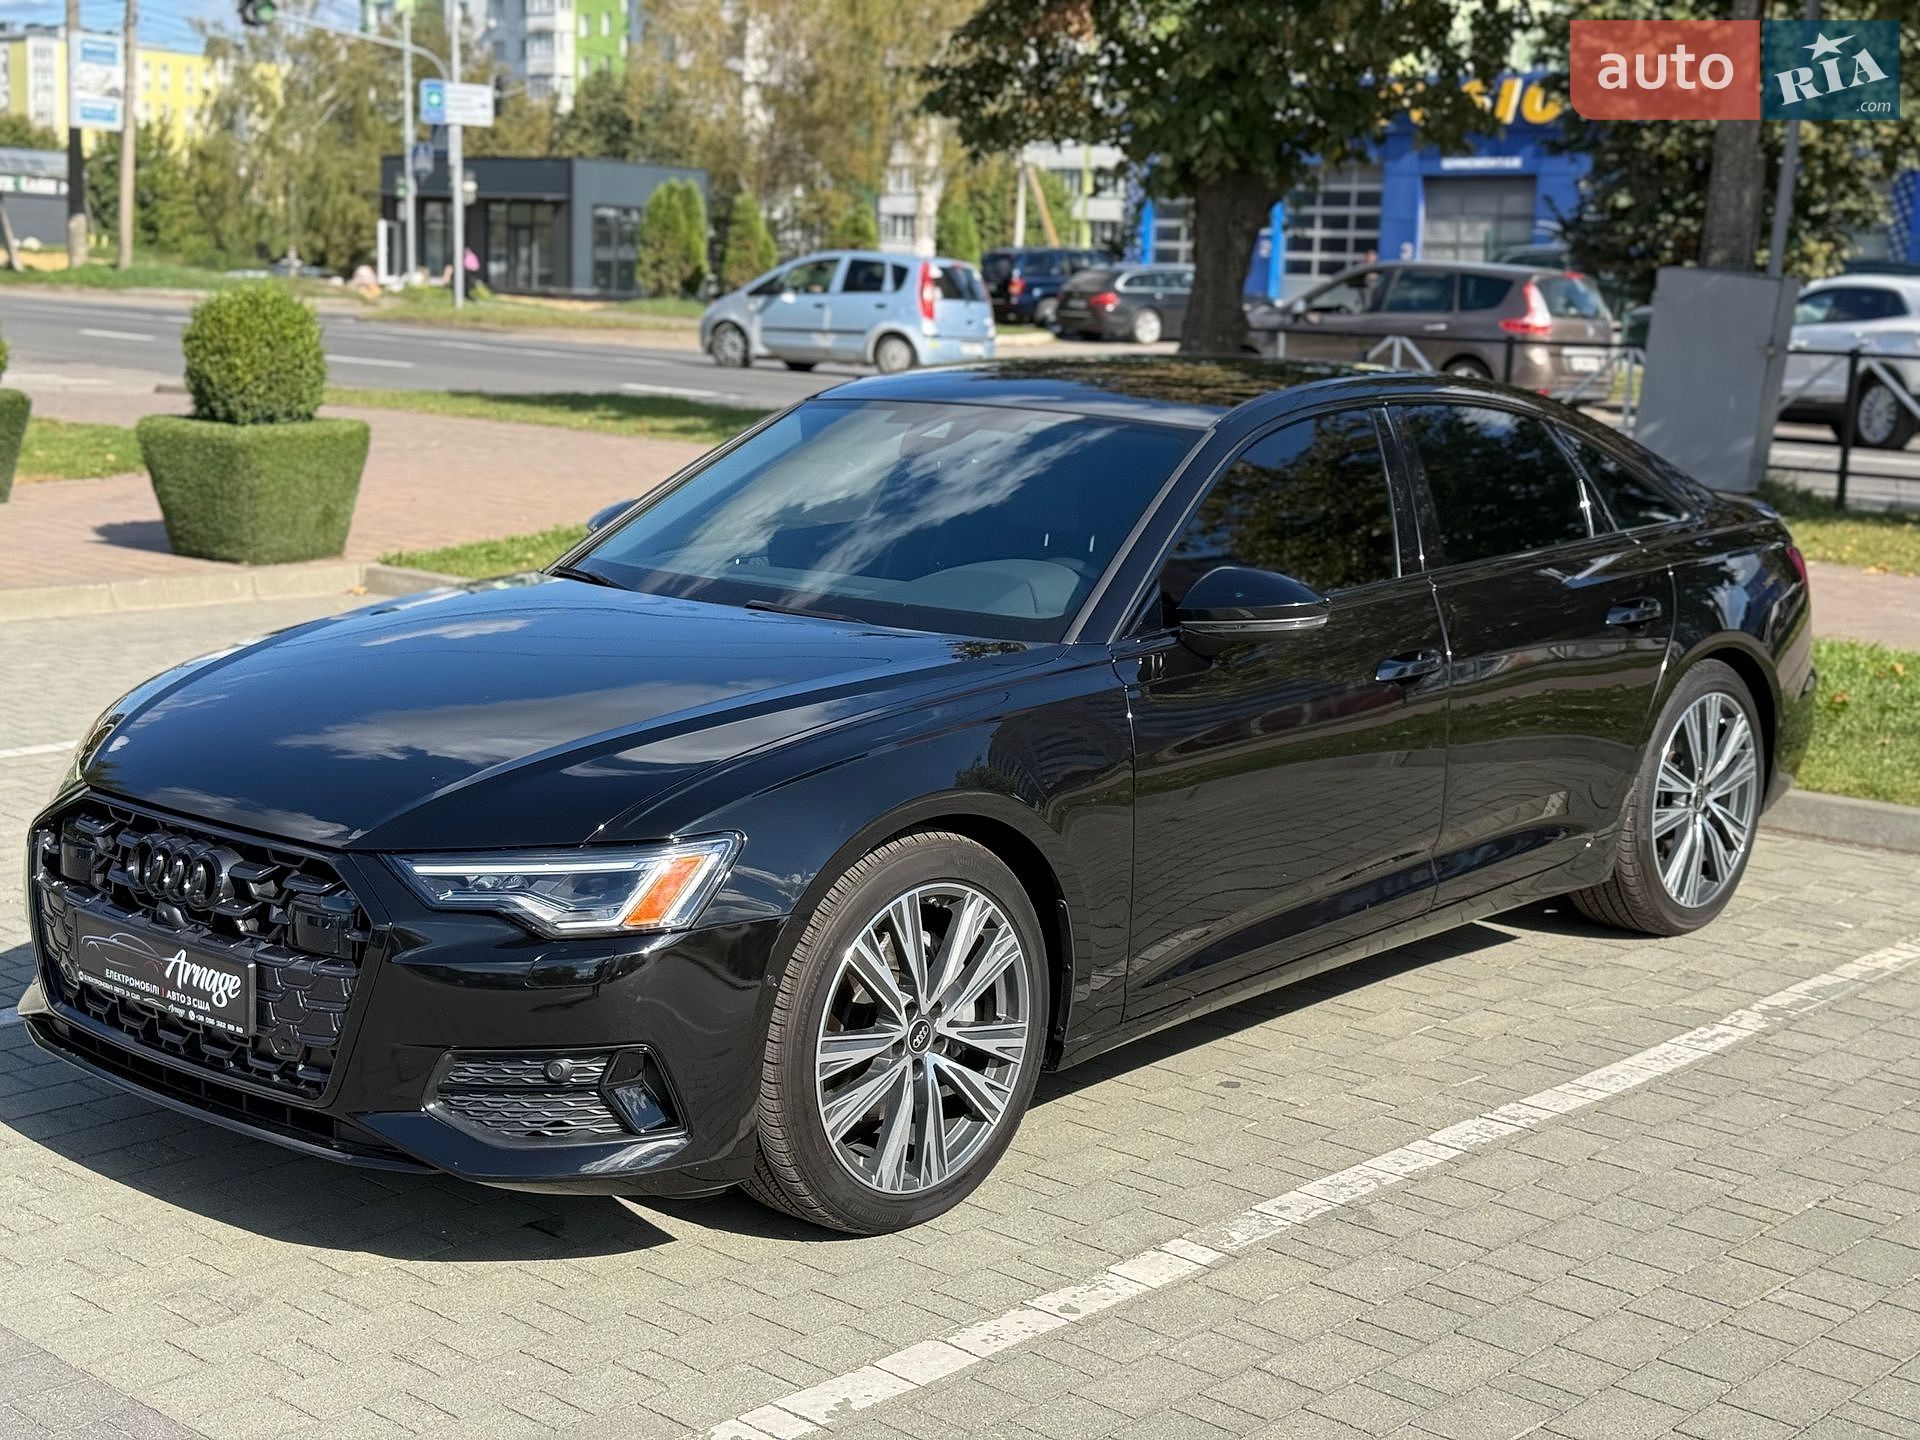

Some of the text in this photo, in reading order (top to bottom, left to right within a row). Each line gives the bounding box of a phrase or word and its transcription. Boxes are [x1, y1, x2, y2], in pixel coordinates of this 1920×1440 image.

[105, 968, 160, 995] ЕЛЕКТРОМОБІЛІ
[166, 991, 186, 1004] АВТО
[193, 998, 211, 1012] США
[162, 949, 241, 1007] Arnage
